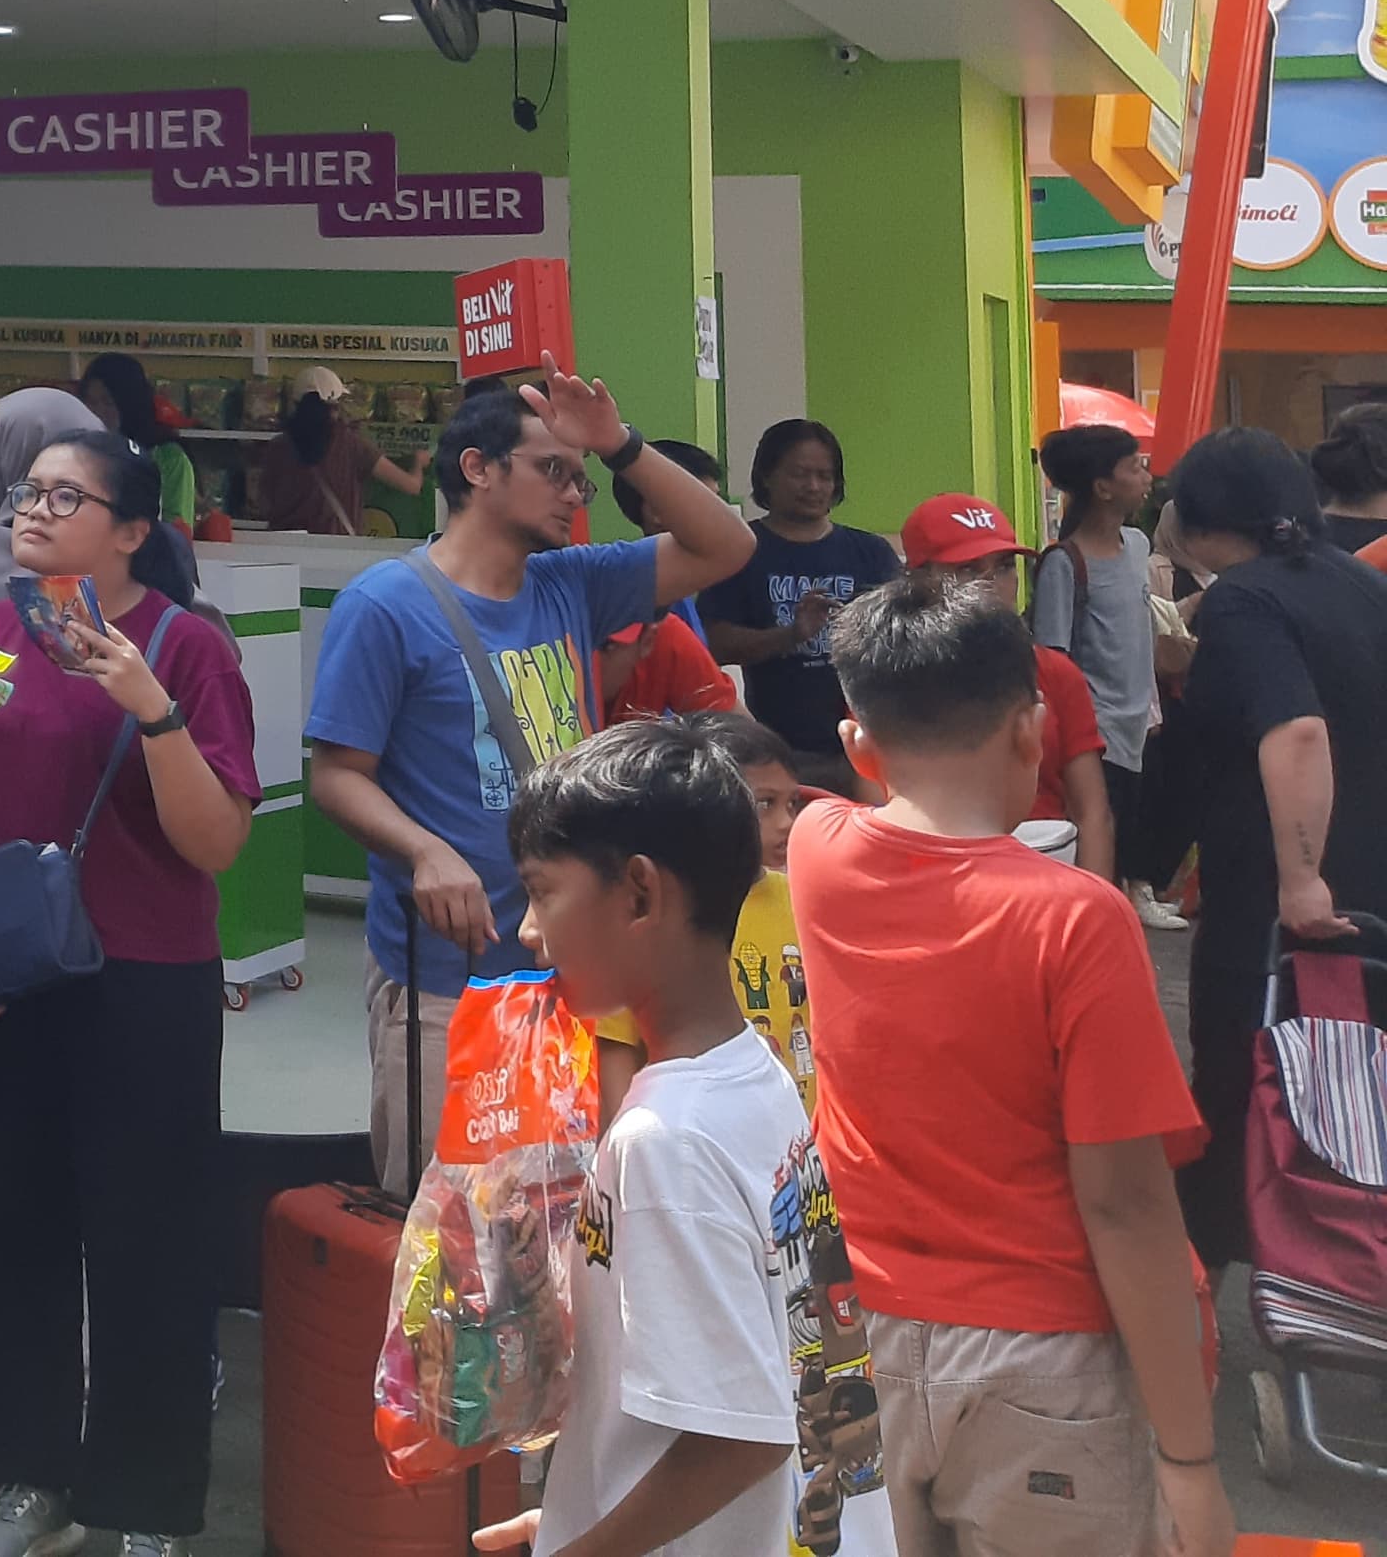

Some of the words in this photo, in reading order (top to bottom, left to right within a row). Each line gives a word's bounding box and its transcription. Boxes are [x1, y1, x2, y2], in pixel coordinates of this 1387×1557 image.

[7, 108, 223, 156] CASHIER
[462, 292, 492, 325] BELI
[13, 329, 65, 344] KUSUKA
[78, 331, 123, 346] HANYA
[125, 332, 139, 346] DI
[143, 331, 207, 348] JAKARTA
[210, 334, 243, 349] FAIR
[271, 334, 318, 349] HARGA
[322, 335, 386, 351] SPESIAL
[390, 337, 449, 352] KUSUKA
[465, 329, 480, 357] DI
[481, 321, 513, 354] SINI!
[950, 507, 996, 531] Vit
